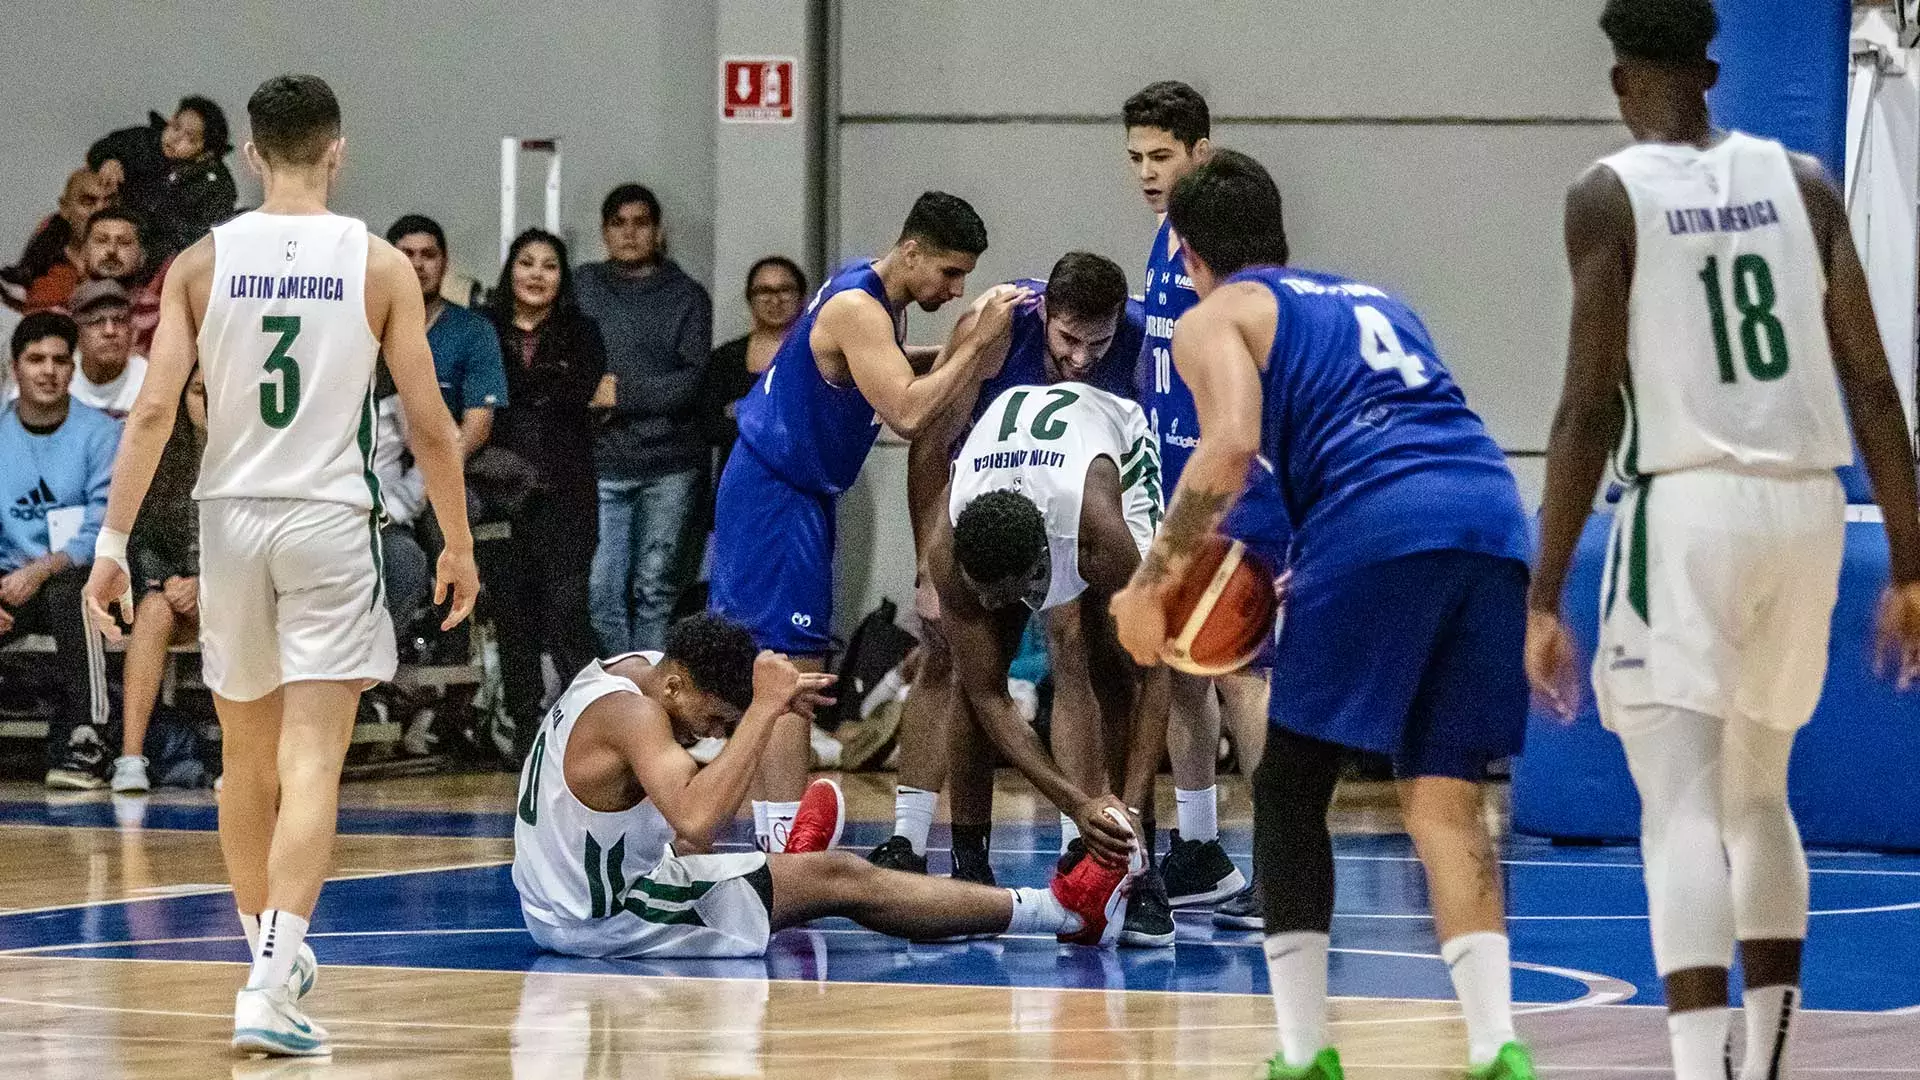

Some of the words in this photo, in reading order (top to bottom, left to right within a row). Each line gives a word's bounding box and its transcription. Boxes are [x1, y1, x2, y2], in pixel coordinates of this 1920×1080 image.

[1665, 208, 1715, 235] LATIN
[230, 275, 274, 299] LATIN
[277, 276, 344, 301] AMERICA
[1699, 253, 1790, 385] 18
[1153, 346, 1171, 395] 10
[1354, 305, 1430, 389] 4
[259, 315, 301, 430] 3
[998, 388, 1080, 442] 21
[974, 449, 1028, 473] AMERICA
[1029, 449, 1066, 468] LATIN
